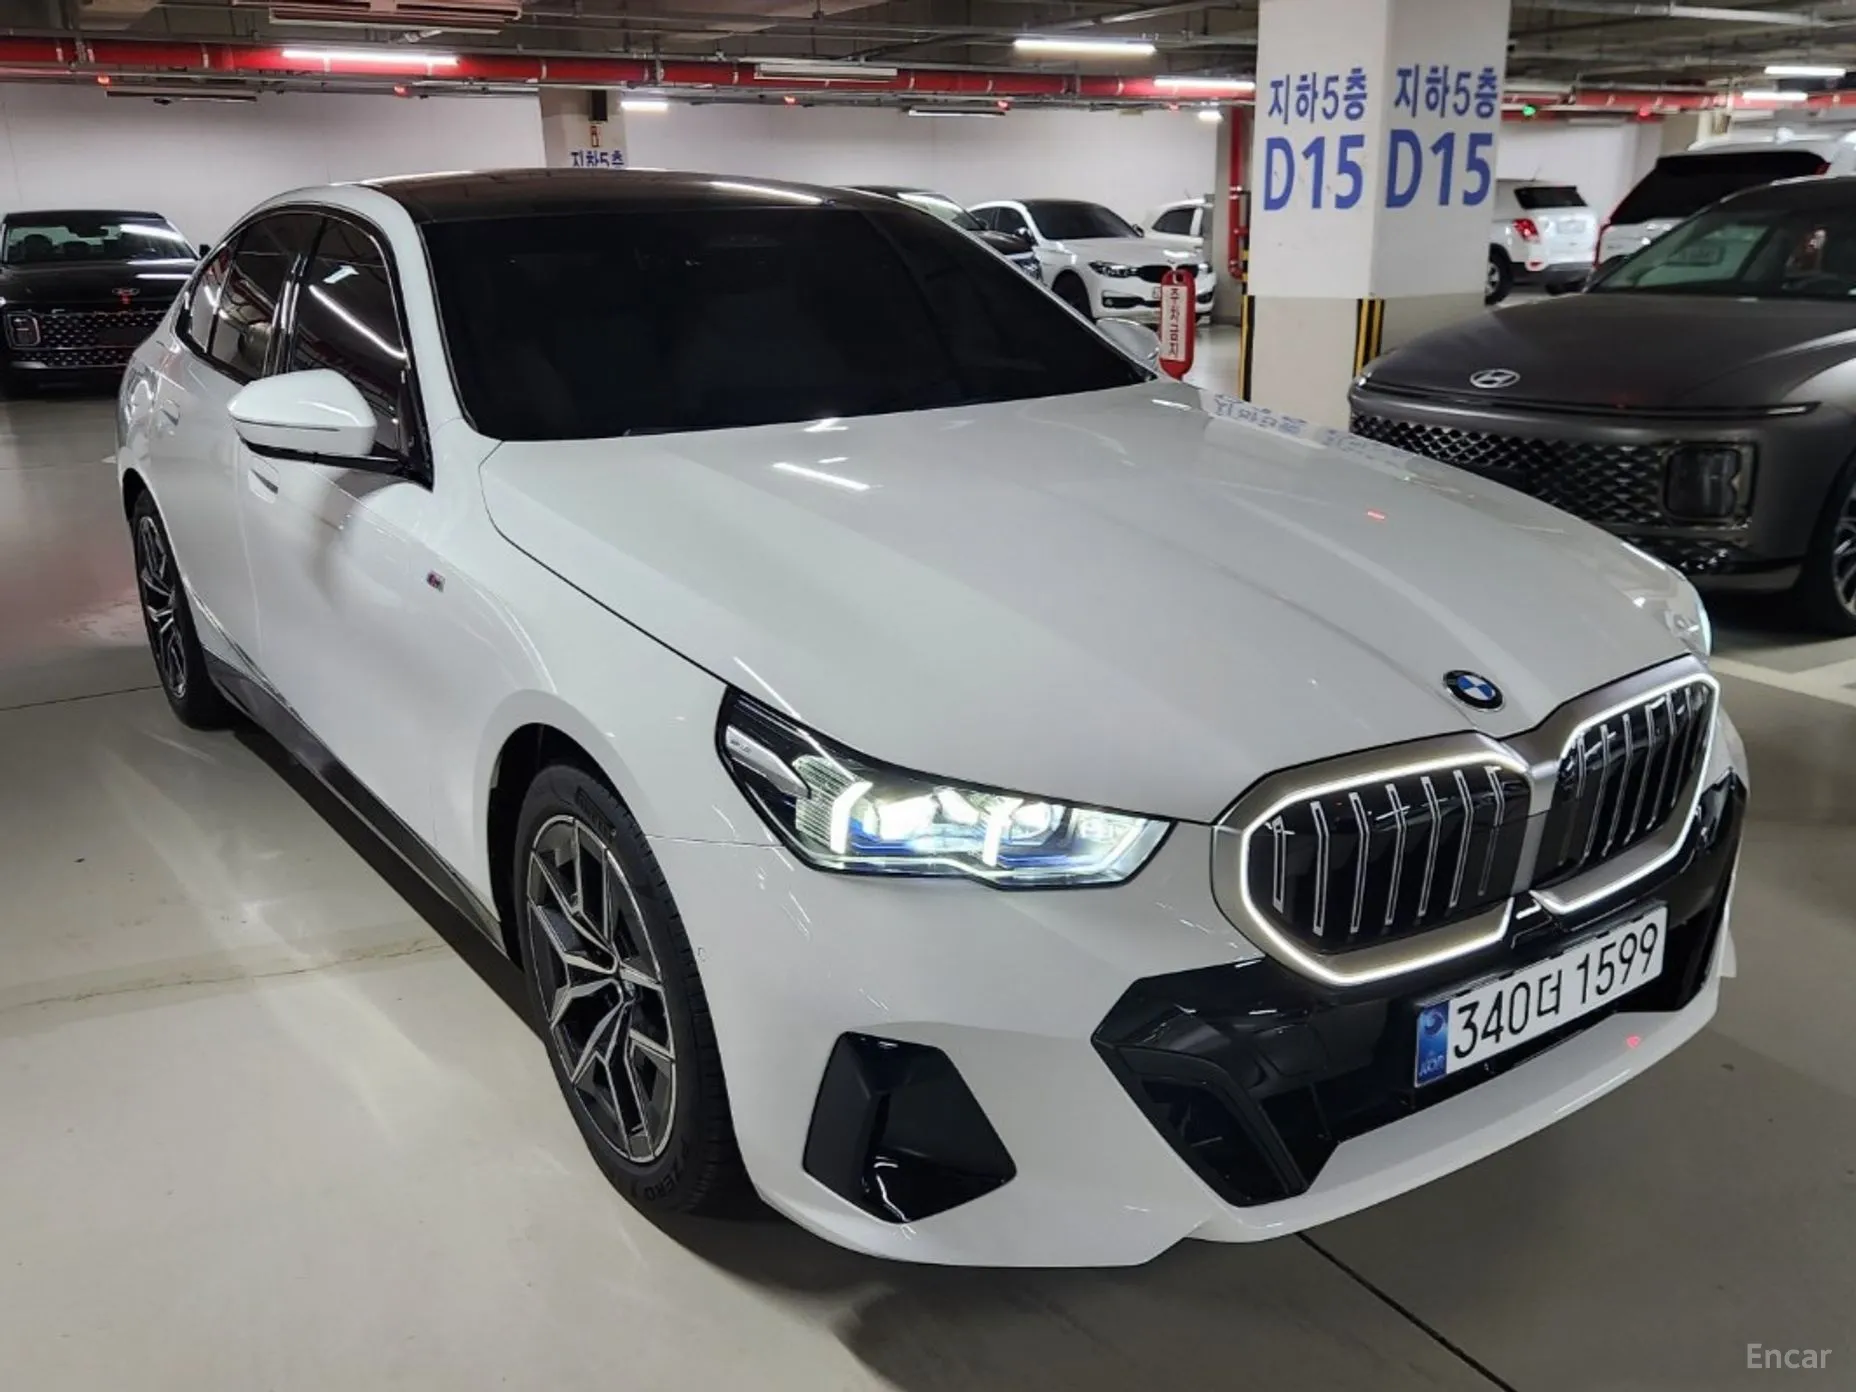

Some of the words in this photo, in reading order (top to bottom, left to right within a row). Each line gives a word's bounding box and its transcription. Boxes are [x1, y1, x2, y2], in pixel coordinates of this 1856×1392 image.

[1268, 67, 1367, 125] 지하5층
[1394, 63, 1498, 119] 지하5층
[1263, 134, 1365, 211] D15
[1385, 128, 1493, 209] D15
[1169, 287, 1180, 358] 주차금지
[1453, 968, 1563, 1059] 340더
[1576, 922, 1659, 1005] 1599
